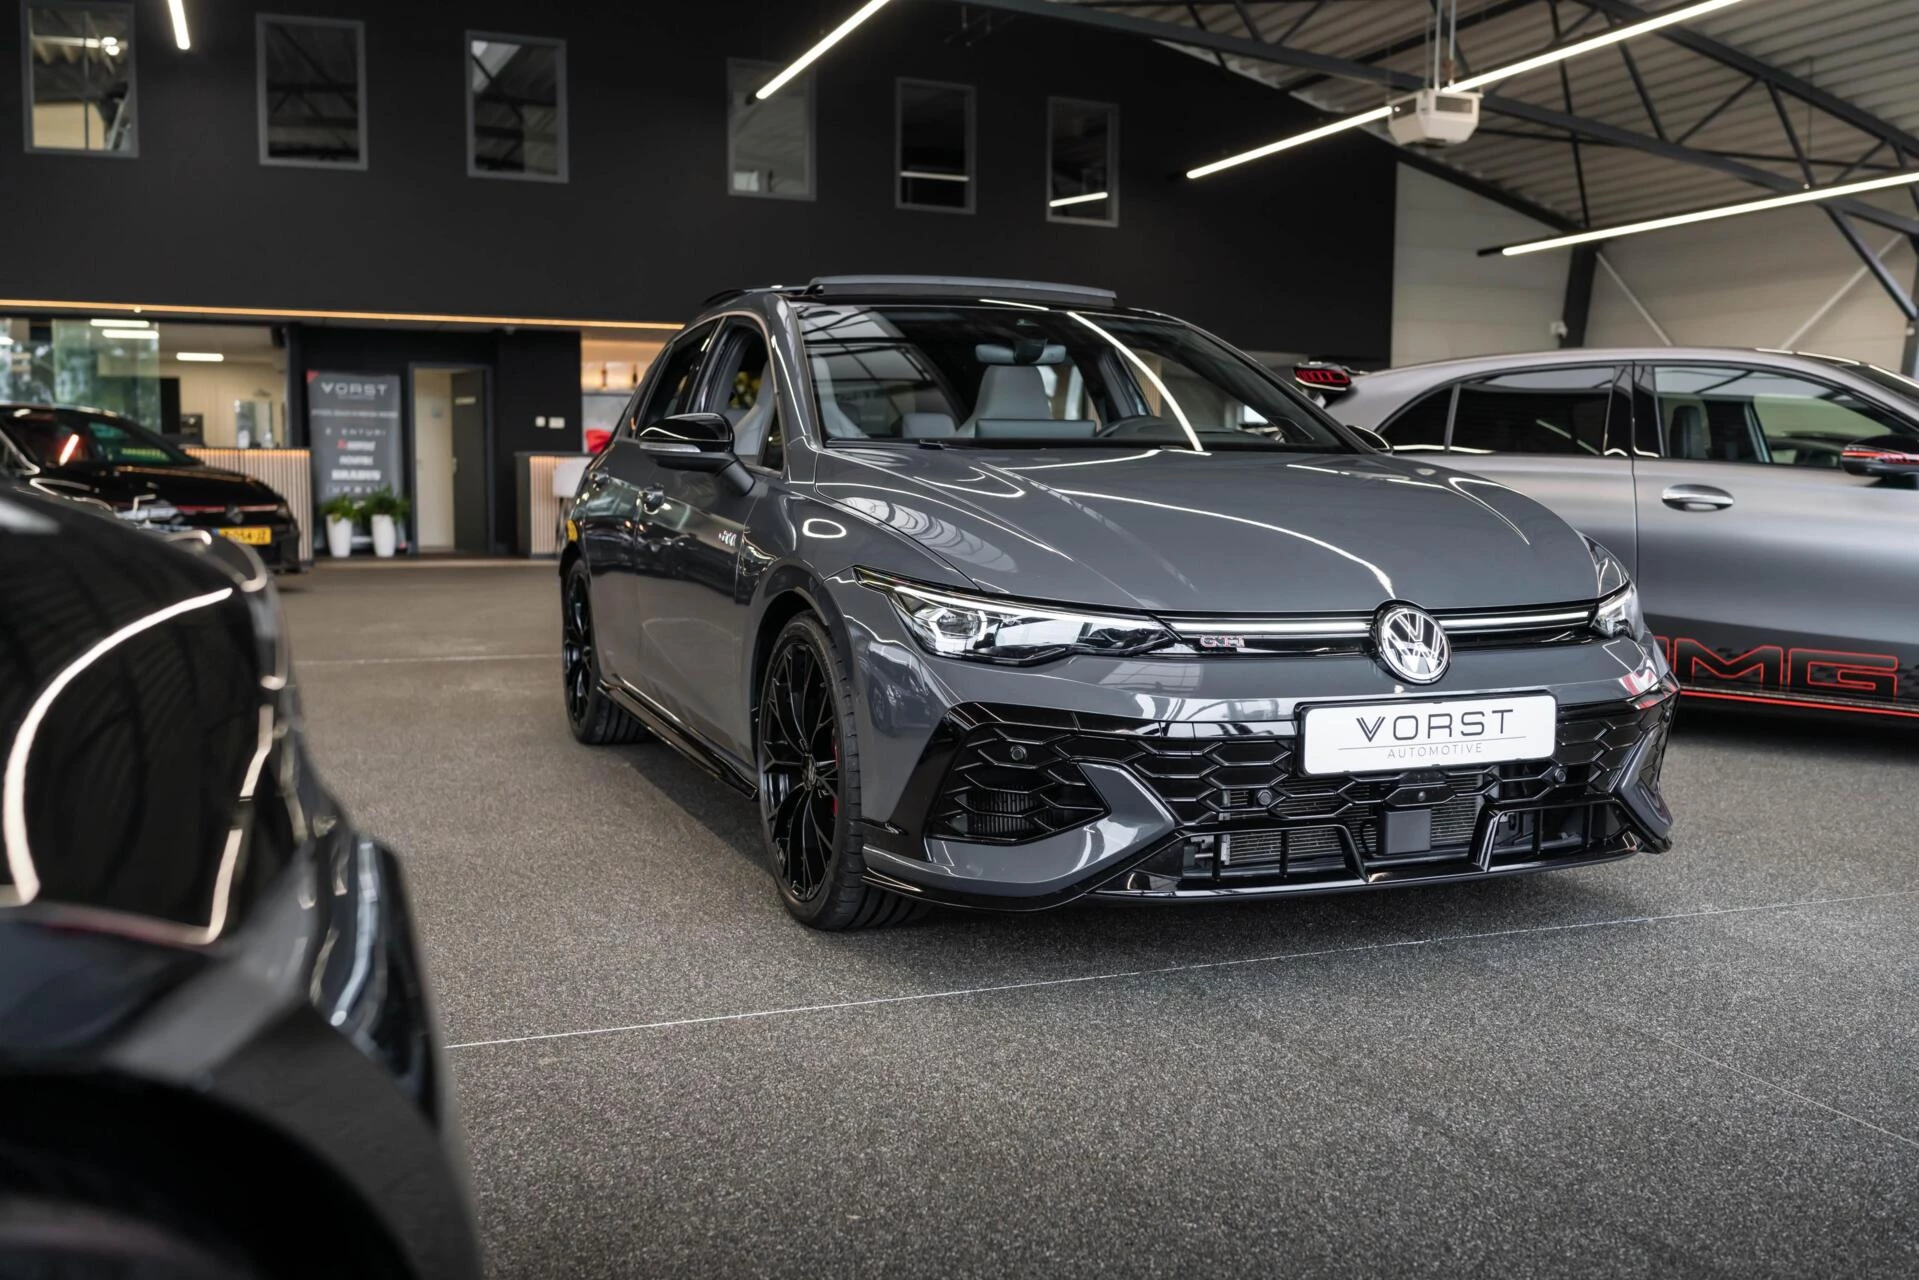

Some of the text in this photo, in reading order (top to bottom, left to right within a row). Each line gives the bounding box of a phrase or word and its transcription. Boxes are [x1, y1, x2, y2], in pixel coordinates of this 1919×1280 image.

[321, 382, 389, 396] VORST
[1654, 636, 1899, 704] MG
[1356, 708, 1514, 743] VORST
[1387, 742, 1483, 760] AUTOMOTIVE
